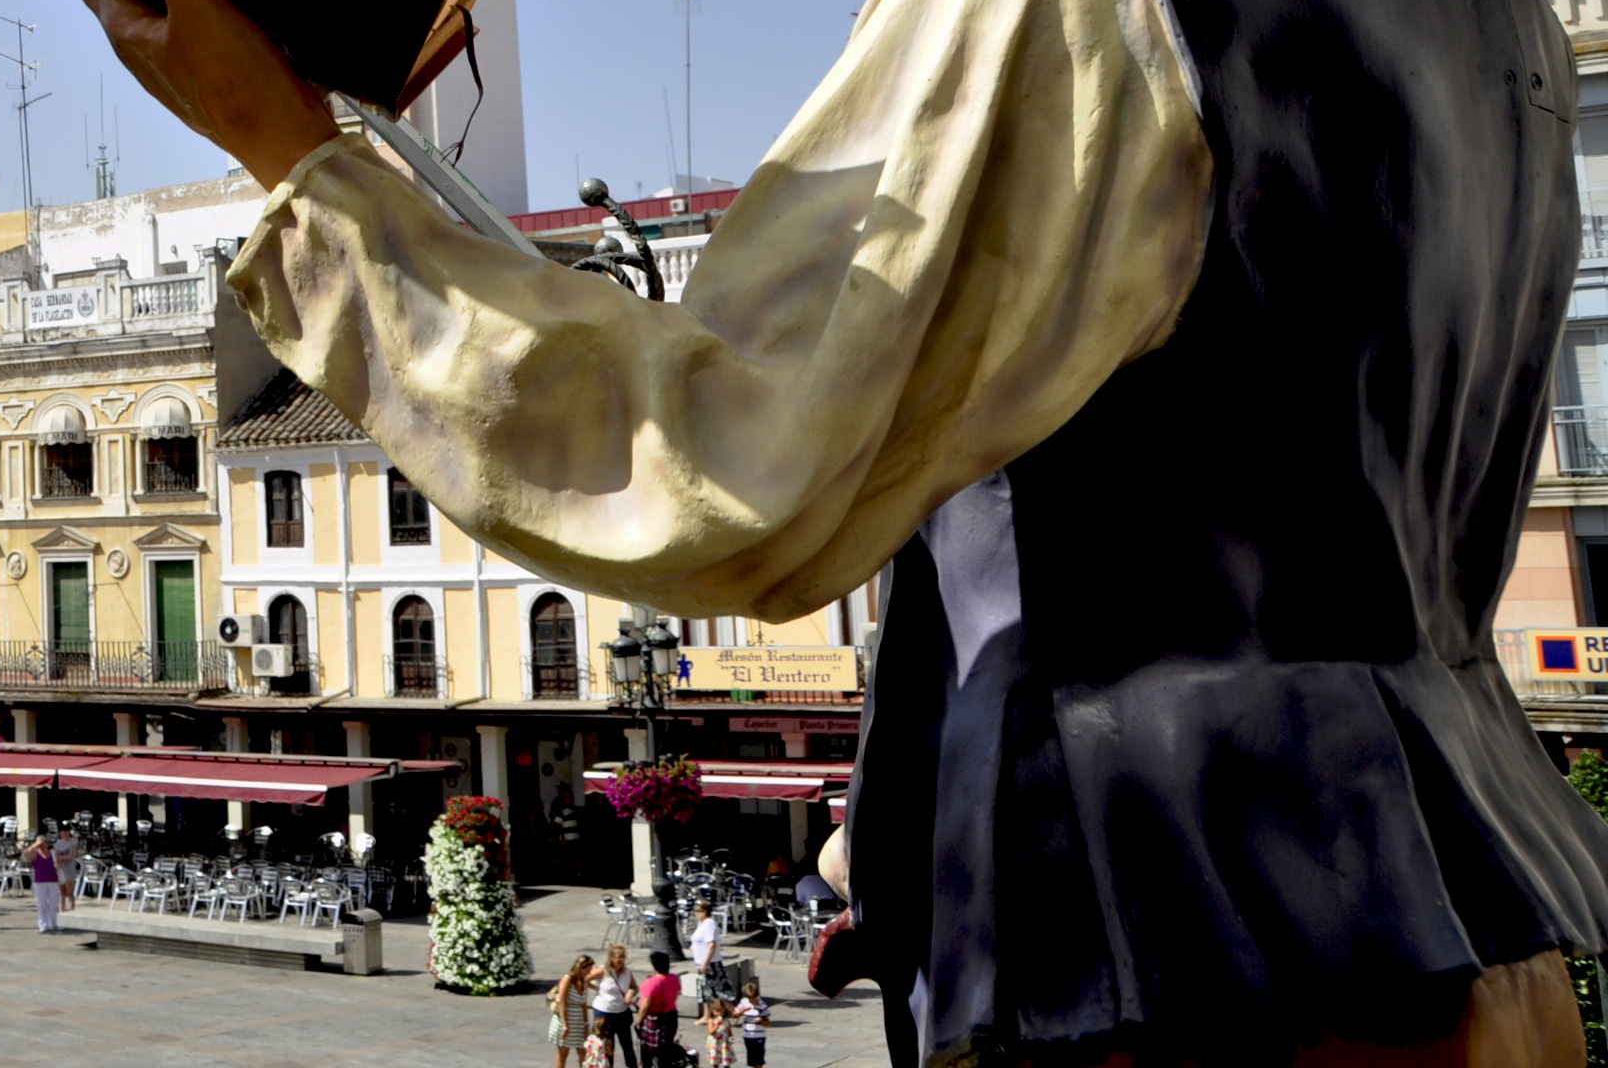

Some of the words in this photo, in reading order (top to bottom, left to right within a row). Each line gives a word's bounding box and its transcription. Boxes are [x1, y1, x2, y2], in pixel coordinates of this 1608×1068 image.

[158, 426, 185, 435] MARI
[52, 432, 78, 441] MARI
[717, 649, 762, 663] Mesón
[766, 649, 843, 662] Restaurante
